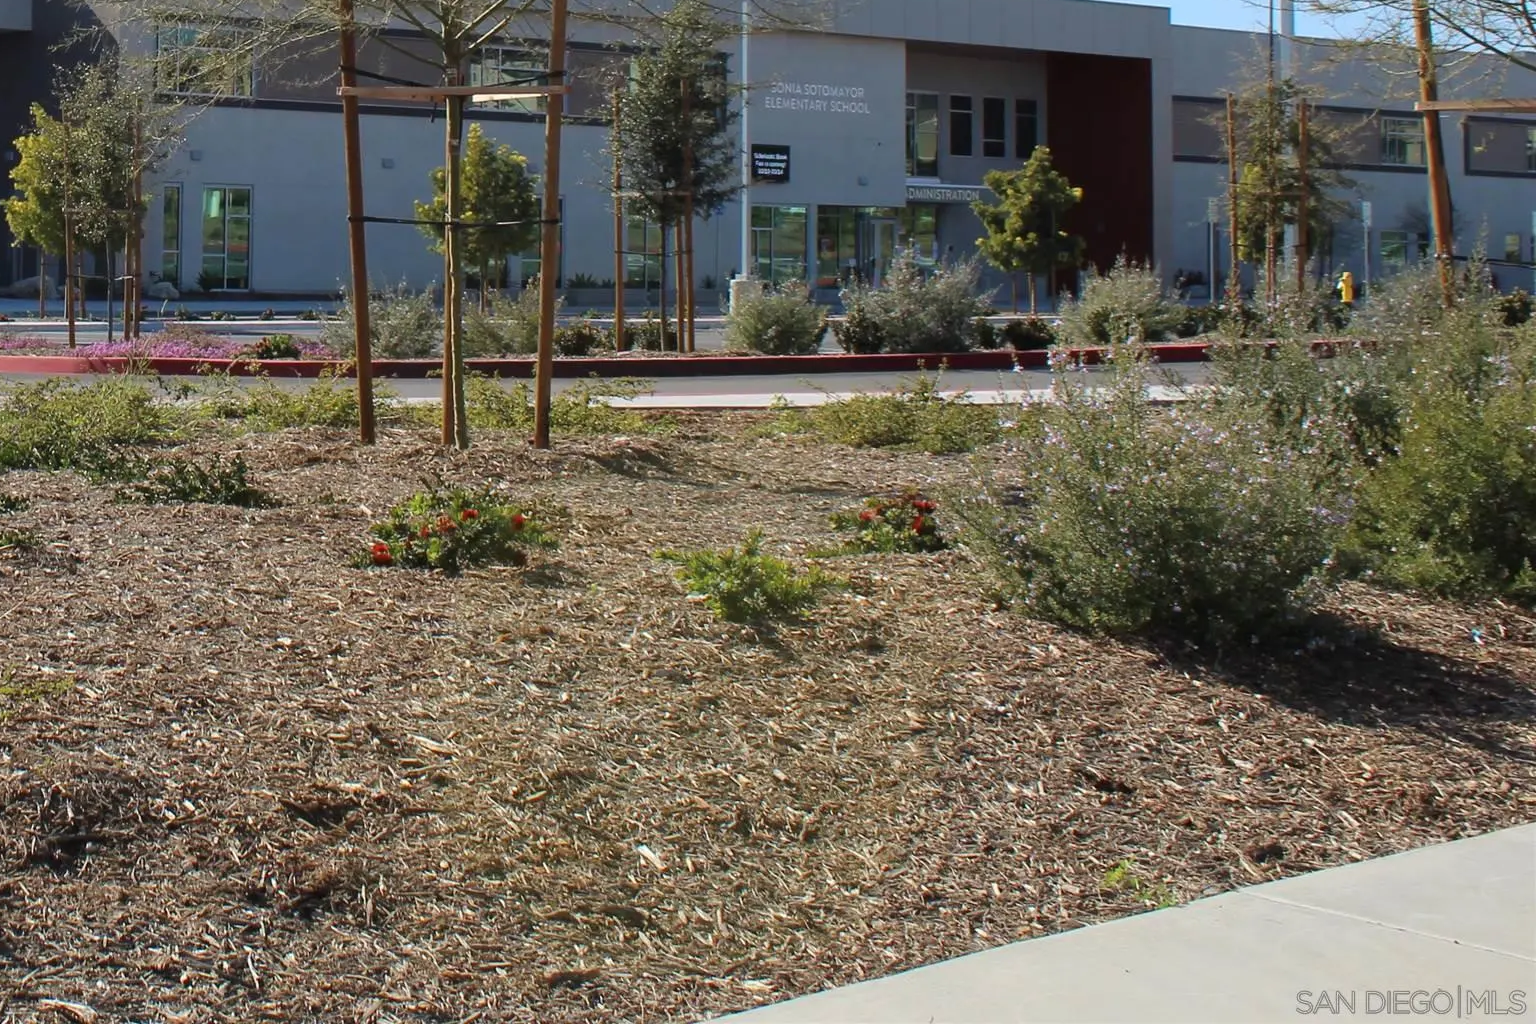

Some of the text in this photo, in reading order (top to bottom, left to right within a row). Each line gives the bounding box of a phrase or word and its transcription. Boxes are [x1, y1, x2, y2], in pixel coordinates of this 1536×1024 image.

[771, 81, 865, 98] SONIA SOTOMAYOR
[764, 96, 870, 114] ELEMENTARY SCHOOL
[906, 187, 980, 201] DMINISTRATION
